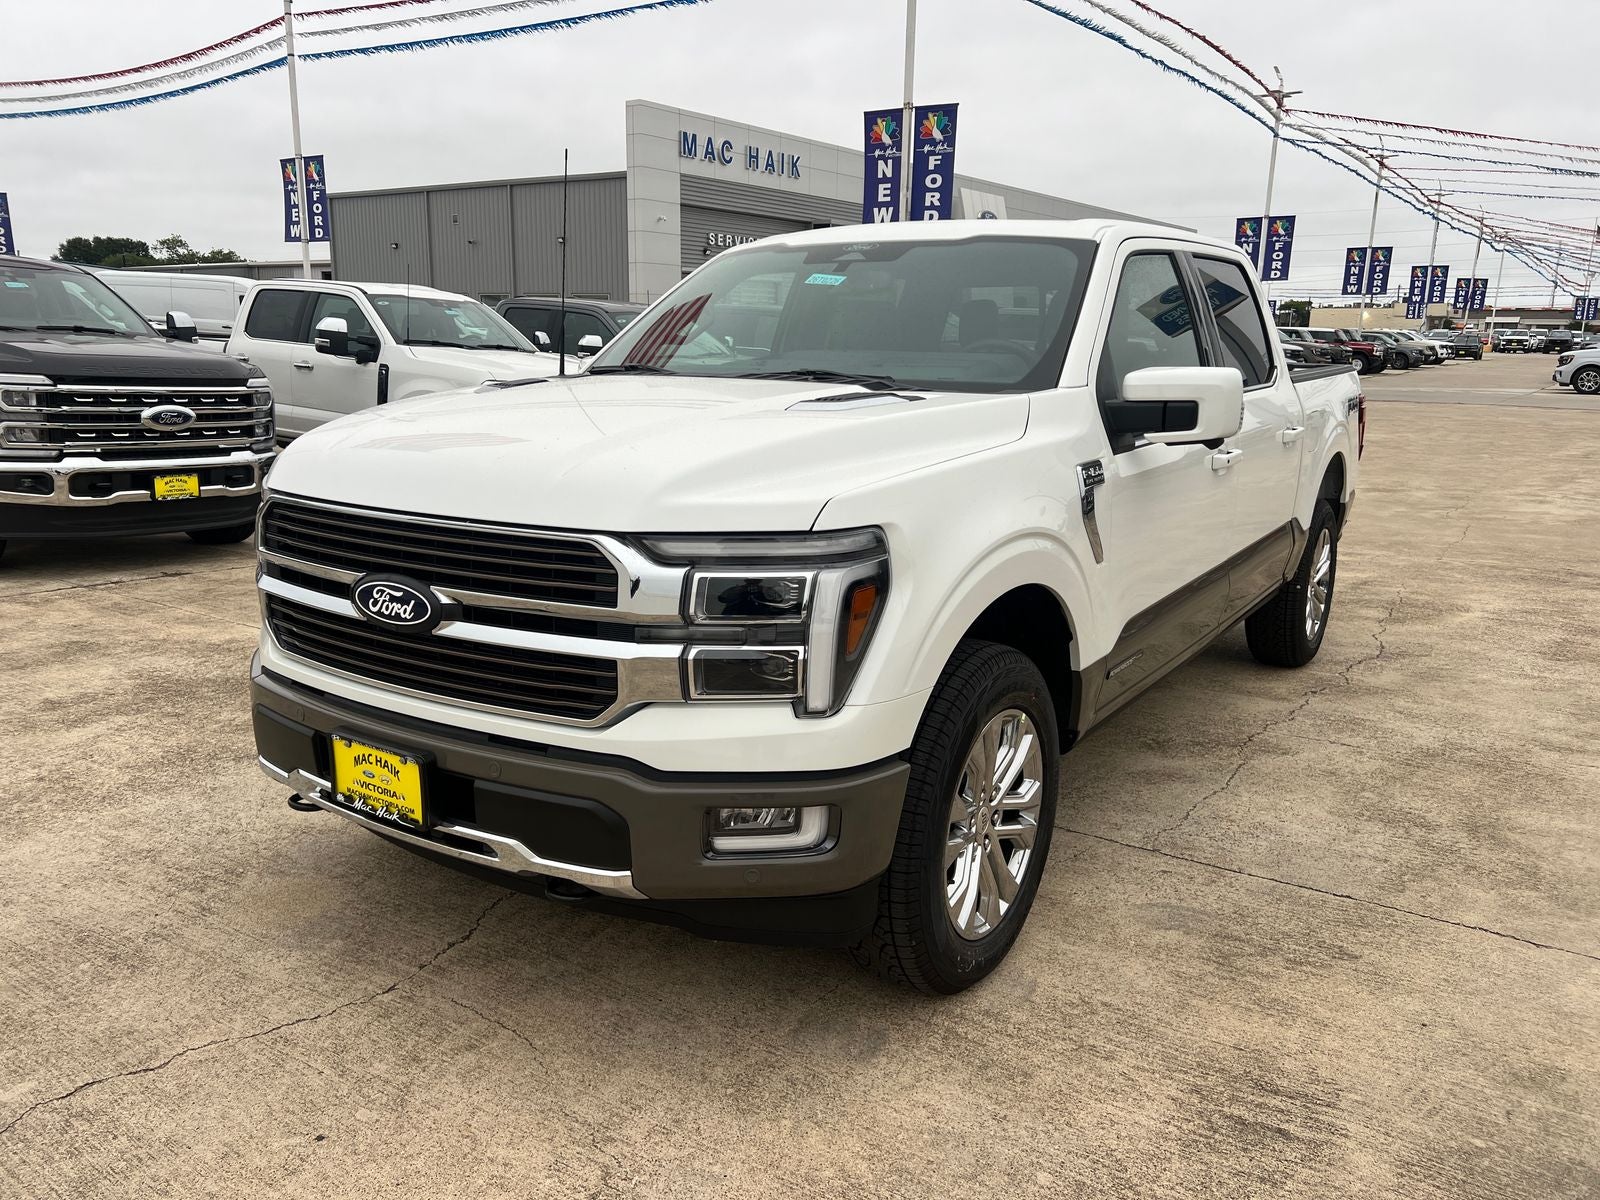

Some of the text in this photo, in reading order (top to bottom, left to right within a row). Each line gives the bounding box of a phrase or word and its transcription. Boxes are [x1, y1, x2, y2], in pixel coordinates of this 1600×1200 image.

[681, 131, 801, 178] MAC HAIK
[873, 159, 894, 223] NEW
[923, 155, 943, 221] FORD
[290, 191, 301, 238] NEW
[313, 191, 324, 238] FORD
[1270, 242, 1284, 278] FORD
[1347, 266, 1360, 293] NEW
[1372, 265, 1384, 293] FORD
[1412, 281, 1422, 302] NEW
[1432, 281, 1441, 302] FORD
[1456, 290, 1465, 308] NEW
[1473, 291, 1482, 309] FORD
[159, 412, 184, 424] Ford
[369, 586, 415, 620] Ford
[353, 753, 401, 781] MAC HAIK
[359, 780, 399, 800] VICTORIA
[352, 797, 400, 821] Mac Haik
